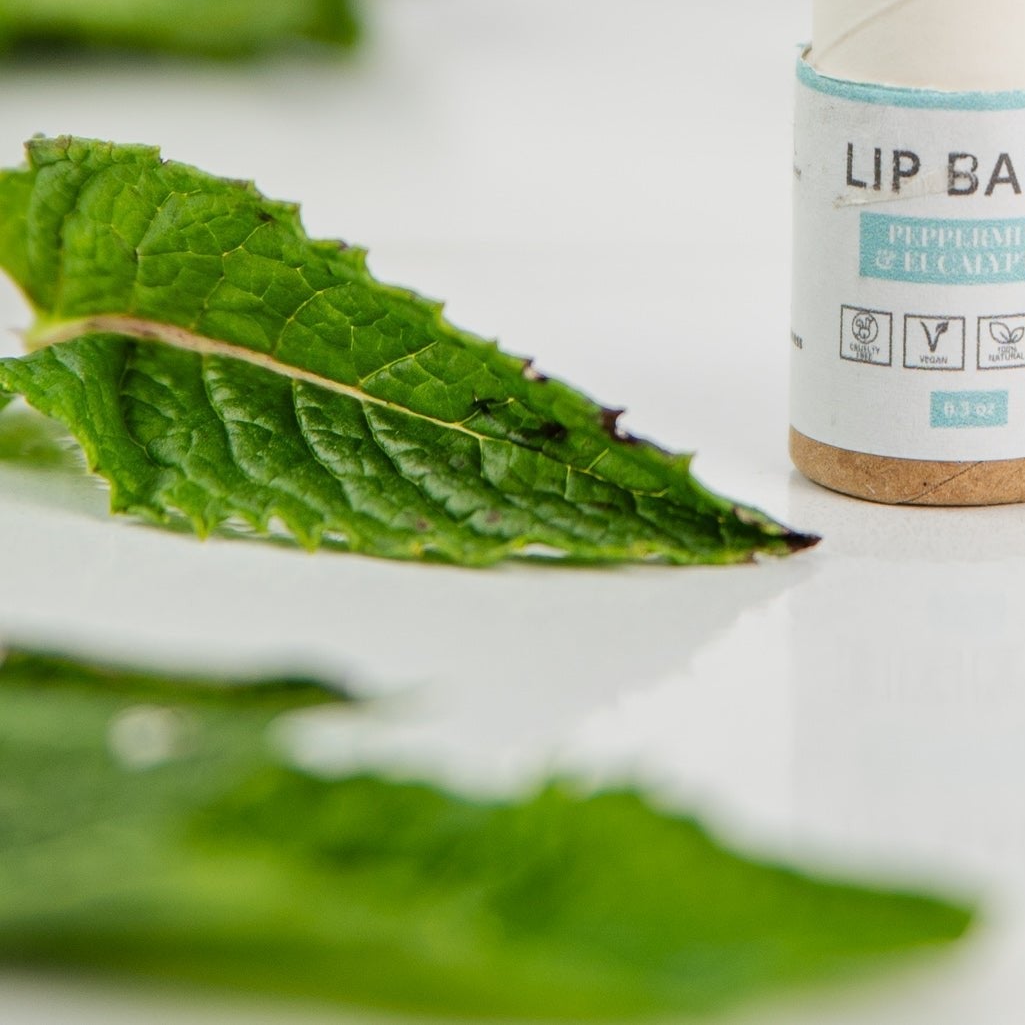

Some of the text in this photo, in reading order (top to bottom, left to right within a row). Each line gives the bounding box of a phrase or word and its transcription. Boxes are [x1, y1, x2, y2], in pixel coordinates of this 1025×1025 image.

[845, 142, 921, 194] LIP
[875, 248, 896, 270] &
[919, 354, 948, 364] VEGAN
[988, 351, 1025, 362] NATURAL
